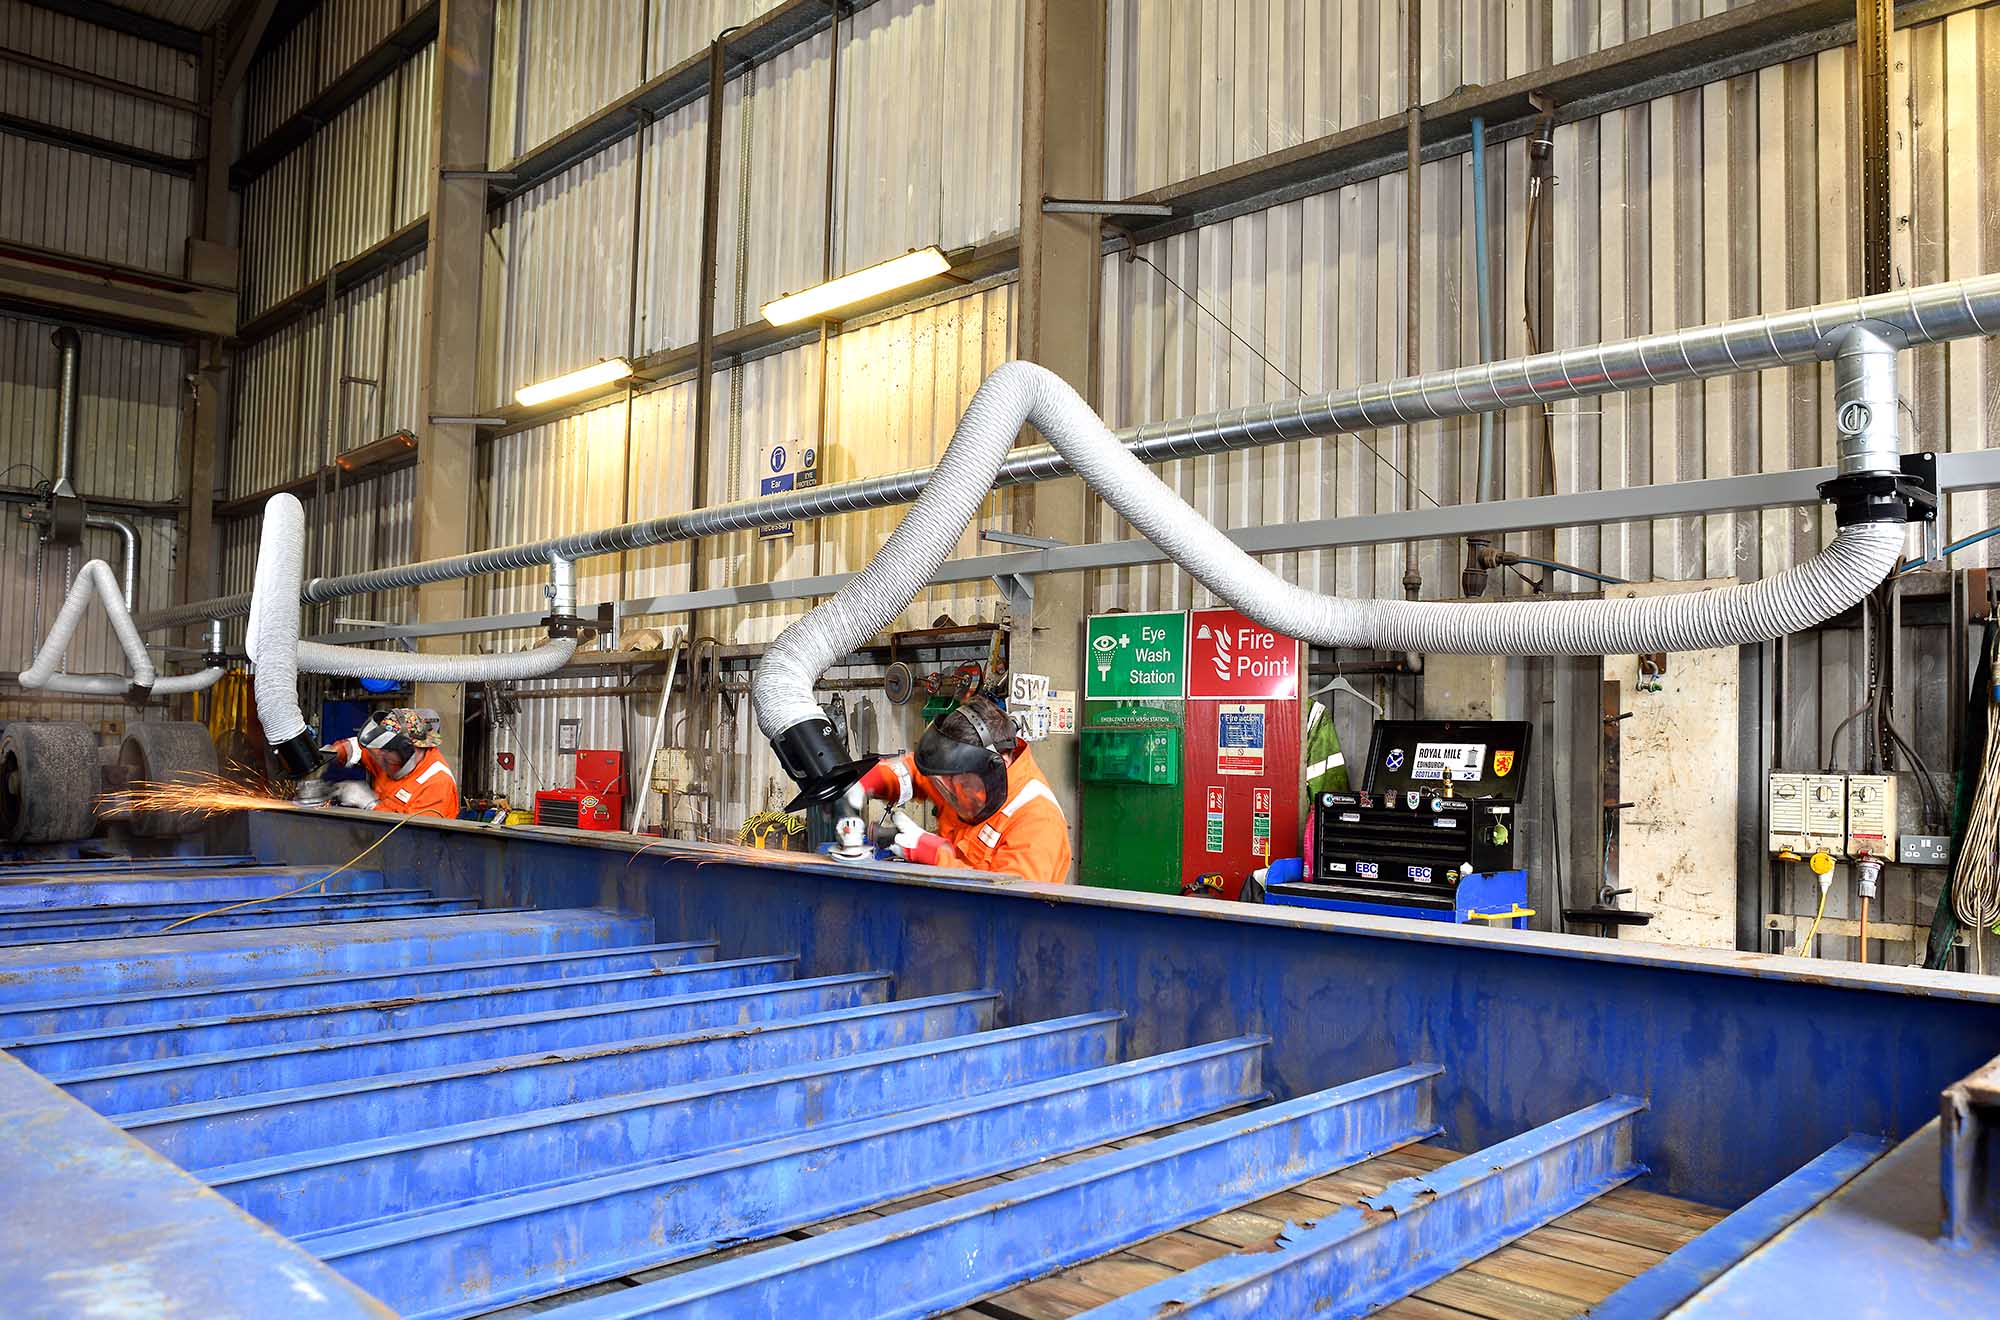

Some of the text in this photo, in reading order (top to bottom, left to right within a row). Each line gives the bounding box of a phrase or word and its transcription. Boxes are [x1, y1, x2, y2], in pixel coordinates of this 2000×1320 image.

[770, 480, 781, 489] Ear
[1141, 626, 1166, 644] Eye
[1237, 628, 1275, 650] Fire
[1135, 648, 1171, 662] Wash
[1236, 655, 1289, 677] Point
[1129, 669, 1175, 685] Station
[1225, 714, 1238, 722] Fire
[1418, 748, 1462, 760] ROYAL MILE
[1416, 761, 1445, 769] EDINBURGH
[1414, 770, 1441, 778] SCOTLAND
[1356, 863, 1377, 874] EBC
[1409, 867, 1431, 878] EBC
